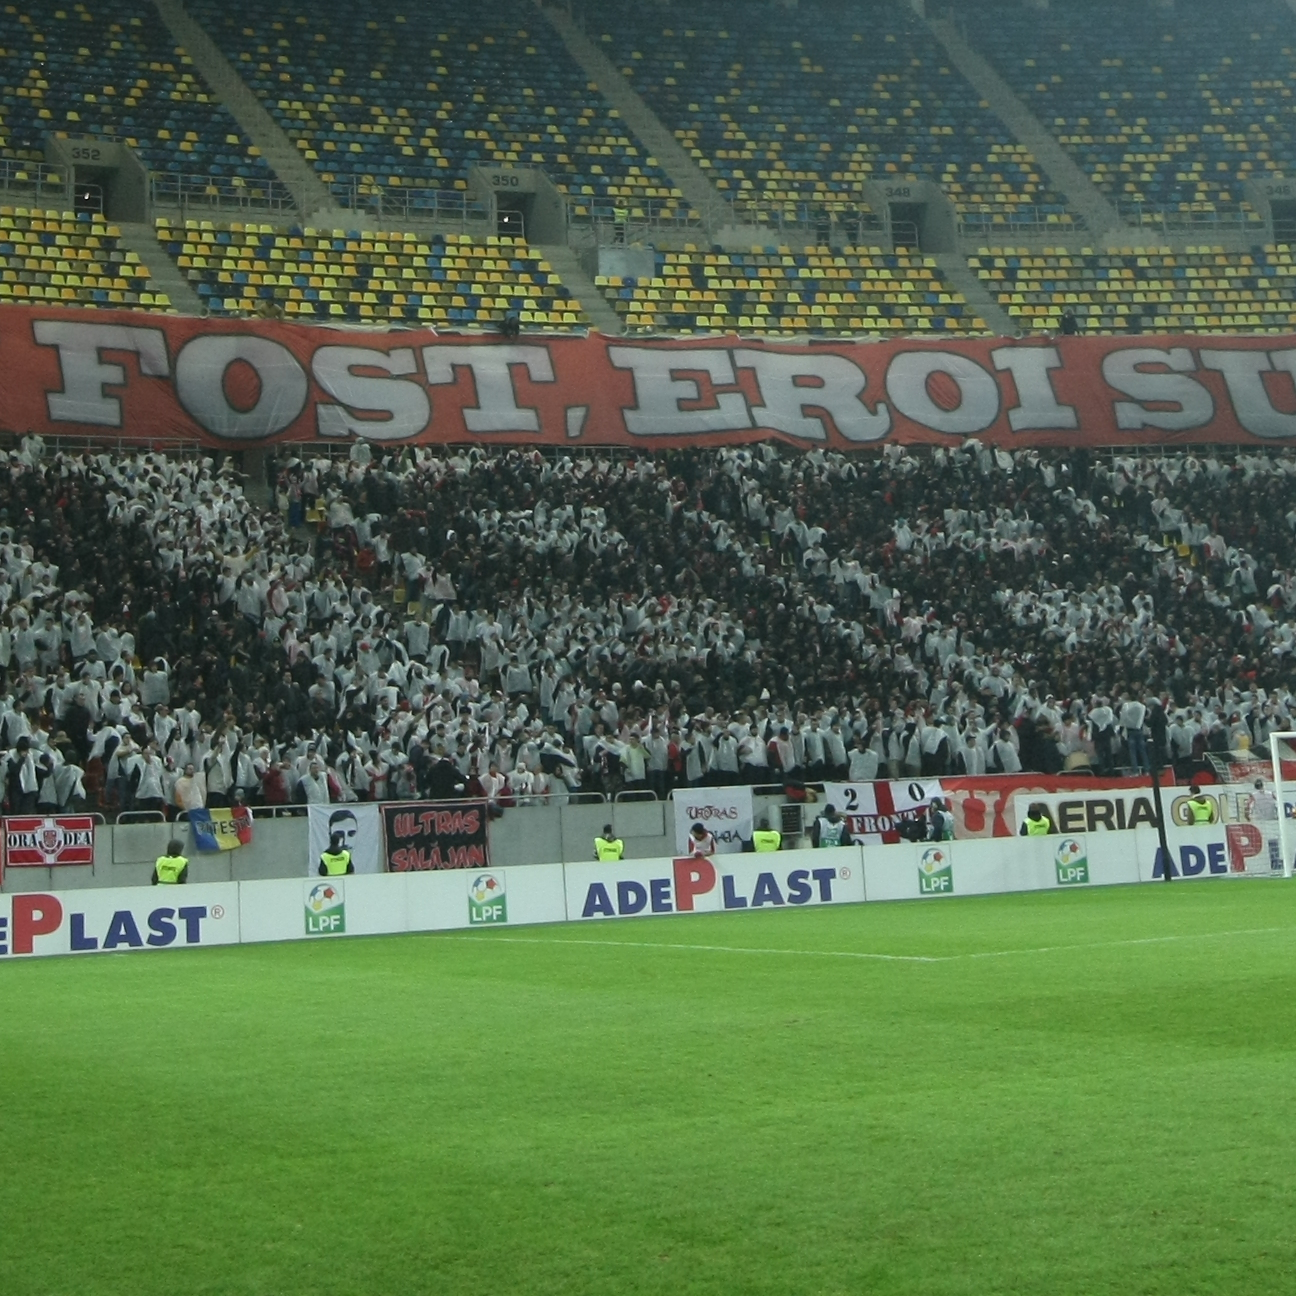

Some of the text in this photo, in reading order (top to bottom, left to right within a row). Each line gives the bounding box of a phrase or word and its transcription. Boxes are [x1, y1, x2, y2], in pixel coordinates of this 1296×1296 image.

[71, 147, 101, 161] 352
[492, 174, 519, 187] 350
[608, 344, 1079, 443] EROI
[393, 809, 481, 838] ULTRAS
[1059, 867, 1085, 881] LPF
[582, 857, 837, 918] ADEPLAST
[922, 876, 950, 892] LPF
[472, 905, 503, 922] LPF
[308, 915, 341, 932] LPF
